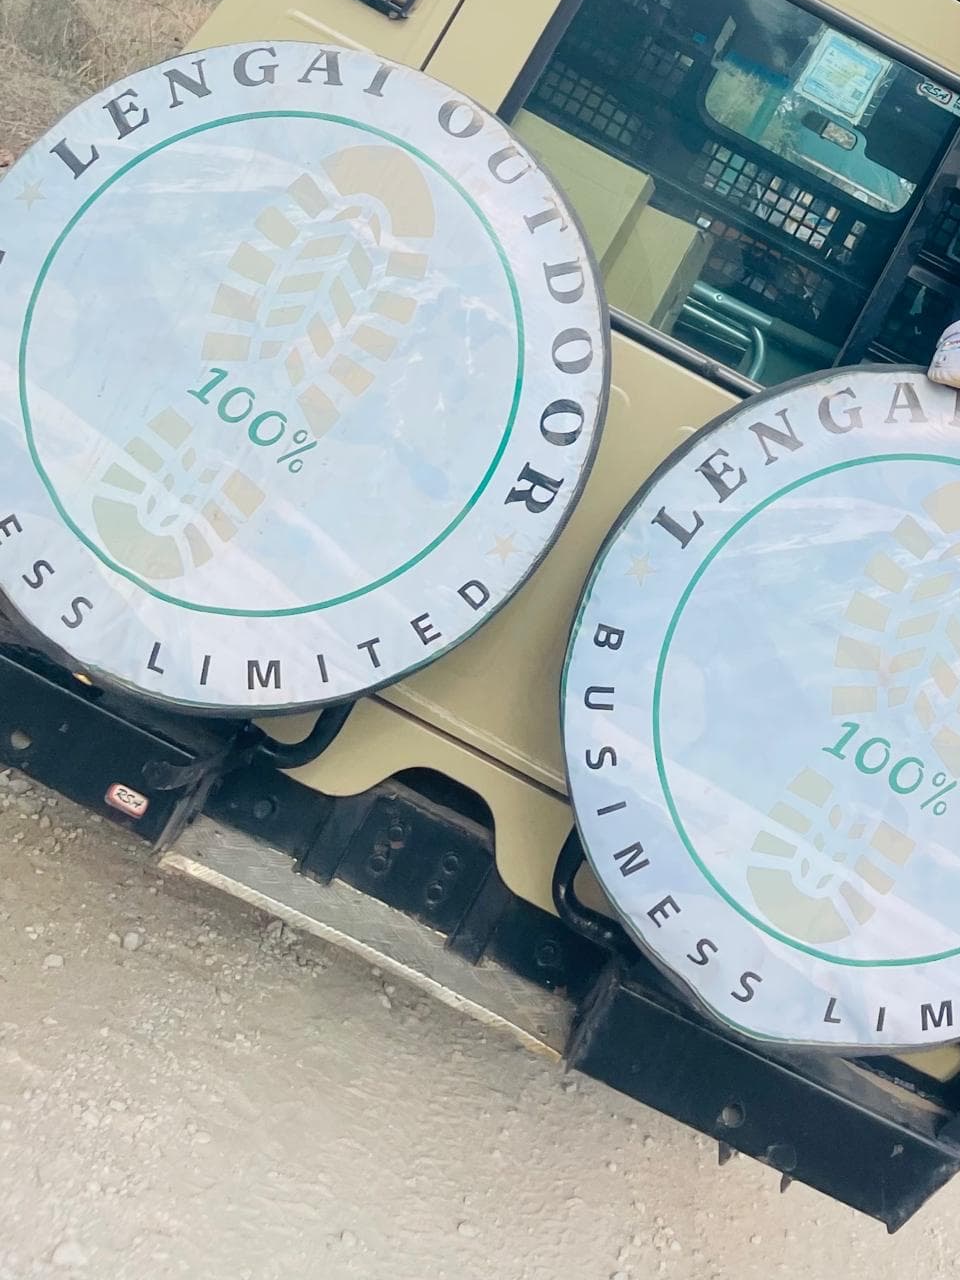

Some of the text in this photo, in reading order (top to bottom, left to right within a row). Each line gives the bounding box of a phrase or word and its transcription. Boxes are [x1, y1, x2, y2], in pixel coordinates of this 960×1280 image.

[922, 82, 949, 101] RSA
[50, 46, 595, 515] LENGAI OUTDOOR
[187, 366, 319, 474] 100%
[147, 579, 491, 690] LIMITED
[583, 623, 762, 1004] BUSINESS
[822, 721, 959, 817] 100%
